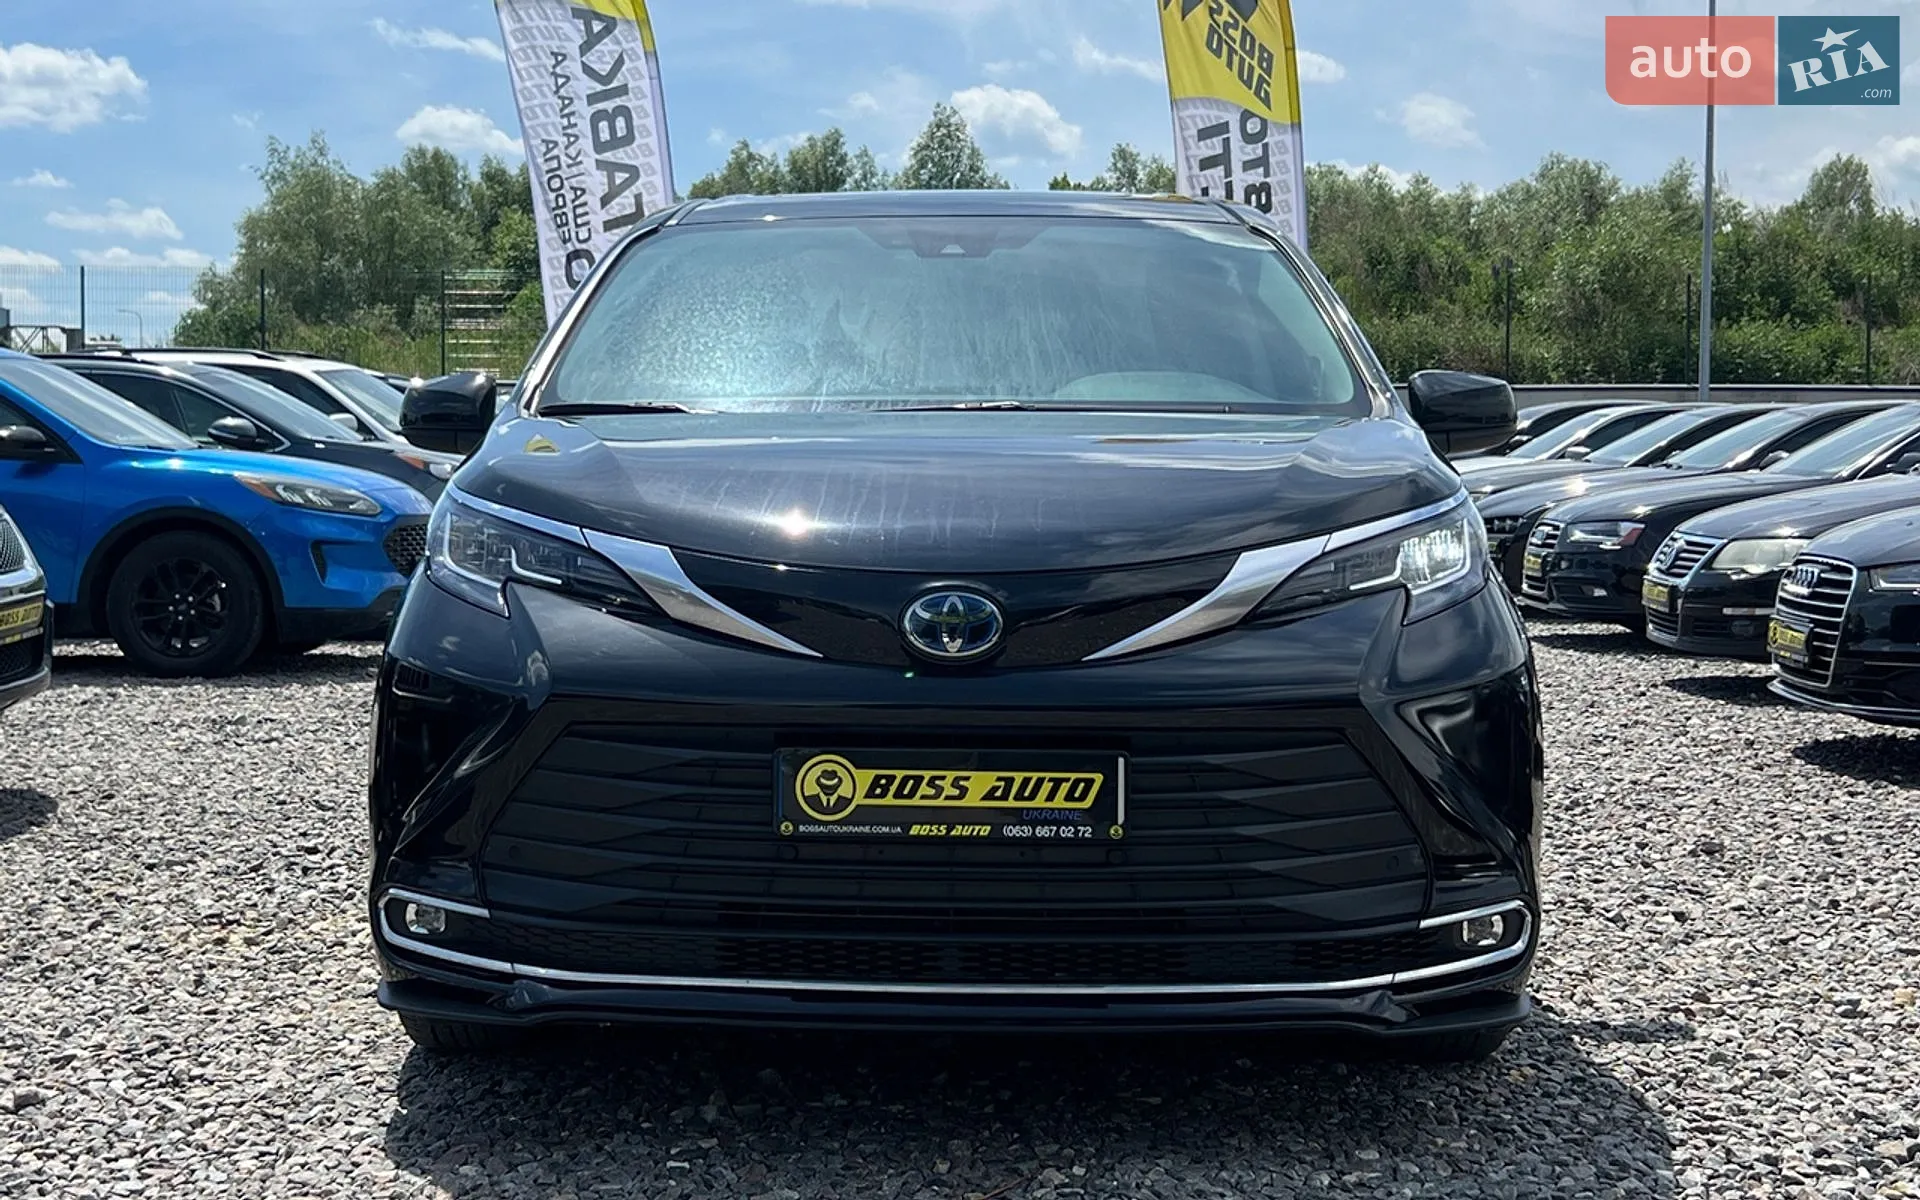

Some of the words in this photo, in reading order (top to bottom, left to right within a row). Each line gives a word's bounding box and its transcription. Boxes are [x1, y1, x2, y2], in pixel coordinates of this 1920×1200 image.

[863, 774, 971, 800] BOSS
[979, 775, 1097, 802] AUTO
[1022, 809, 1083, 821] UKRAINE
[909, 825, 948, 836] BOSS
[950, 825, 991, 836] AUTO
[1003, 825, 1033, 838] (063)
[1035, 826, 1057, 837] 667
[1059, 826, 1074, 838] 02
[1077, 826, 1093, 838] 72
